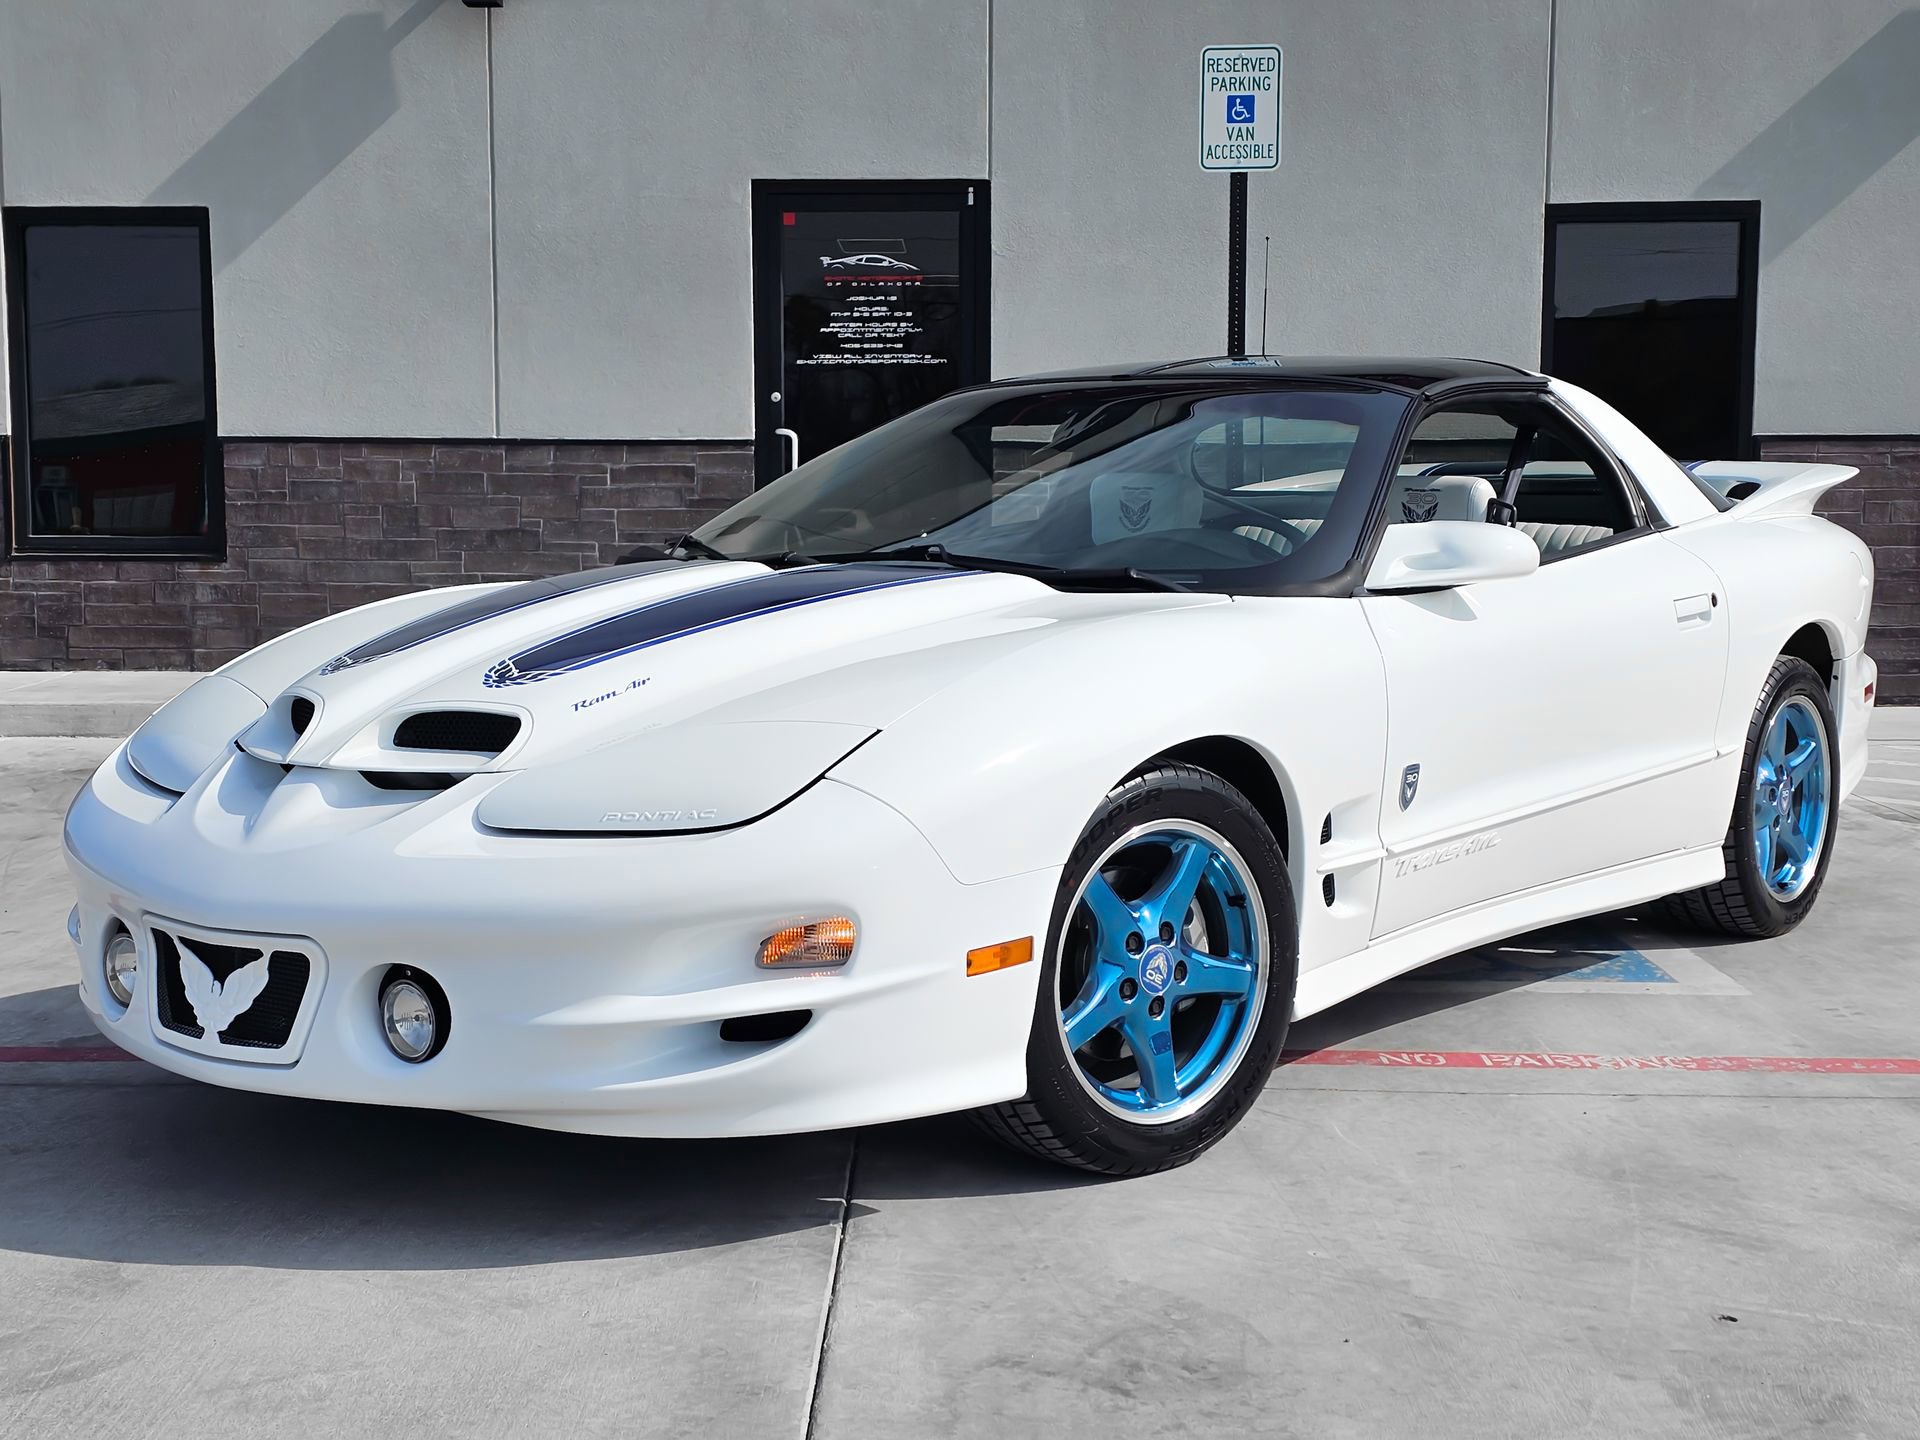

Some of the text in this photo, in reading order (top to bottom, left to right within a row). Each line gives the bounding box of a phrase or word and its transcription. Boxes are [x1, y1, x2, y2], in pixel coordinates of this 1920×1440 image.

[1207, 57, 1276, 73] RESERVED
[1211, 76, 1271, 92] PARKING
[1226, 126, 1255, 142] VAN
[1206, 143, 1274, 160] ACCESSIBLE
[1406, 492, 1437, 504] 30
[570, 677, 651, 712] Ram Air
[1406, 773, 1418, 783] 30
[601, 807, 718, 823] PONTIAC
[1377, 1051, 1697, 1070] NO PARKING
